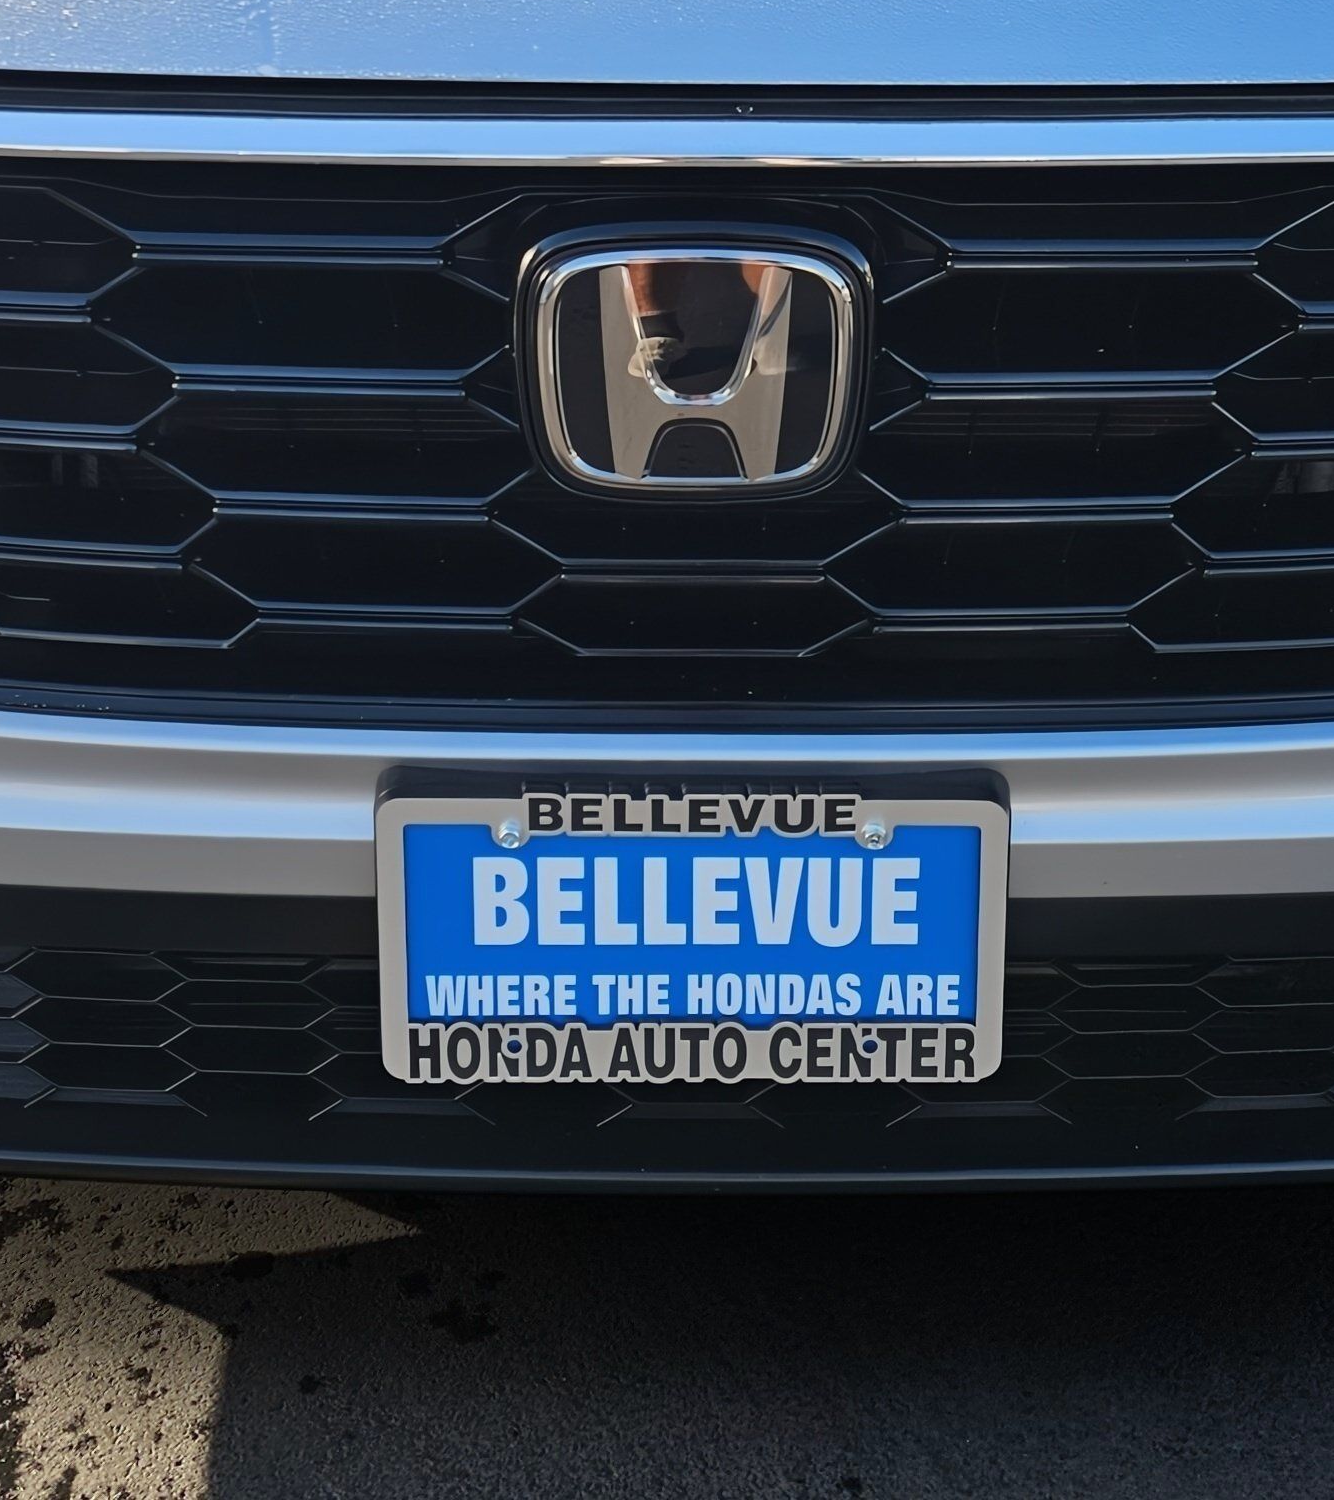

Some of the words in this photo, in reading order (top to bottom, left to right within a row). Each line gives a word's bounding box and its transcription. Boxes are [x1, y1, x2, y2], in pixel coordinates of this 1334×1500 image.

[526, 797, 858, 833] BELLEVUE
[472, 855, 922, 948] BELLEVUE
[425, 973, 577, 1017] WHERE
[592, 973, 670, 1016] THE
[687, 972, 862, 1017] HONDAS
[875, 973, 961, 1016] ARE
[408, 1026, 593, 1080] HONDA
[607, 1025, 748, 1079] AUTO
[769, 1025, 976, 1079] CENTER
